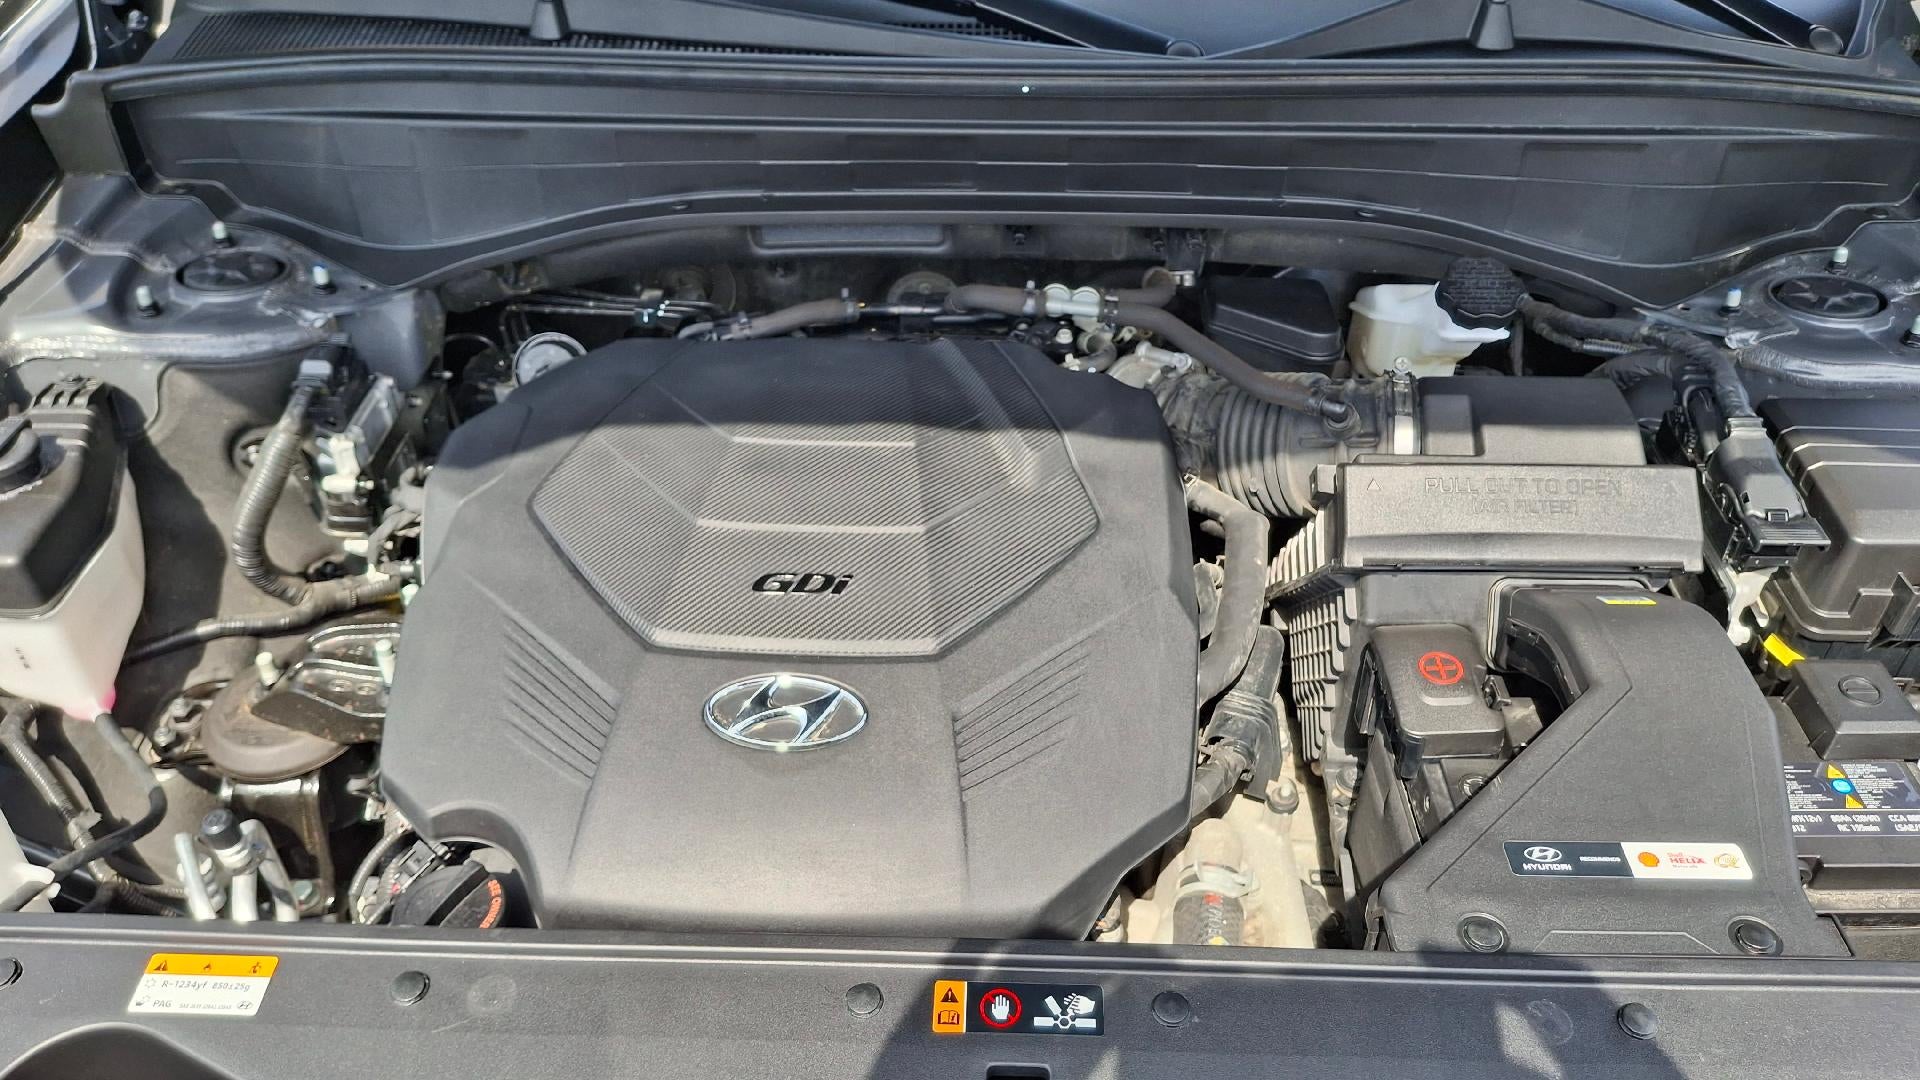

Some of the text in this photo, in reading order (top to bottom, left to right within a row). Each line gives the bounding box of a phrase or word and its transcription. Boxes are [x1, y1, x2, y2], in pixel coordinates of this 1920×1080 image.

[1424, 477, 1623, 497] PULL OUT TO OPEN
[752, 573, 854, 595] GDi
[1522, 863, 1572, 871] HYUNDAI
[161, 980, 208, 990] R-1234yf
[152, 1000, 172, 1008] PAG
